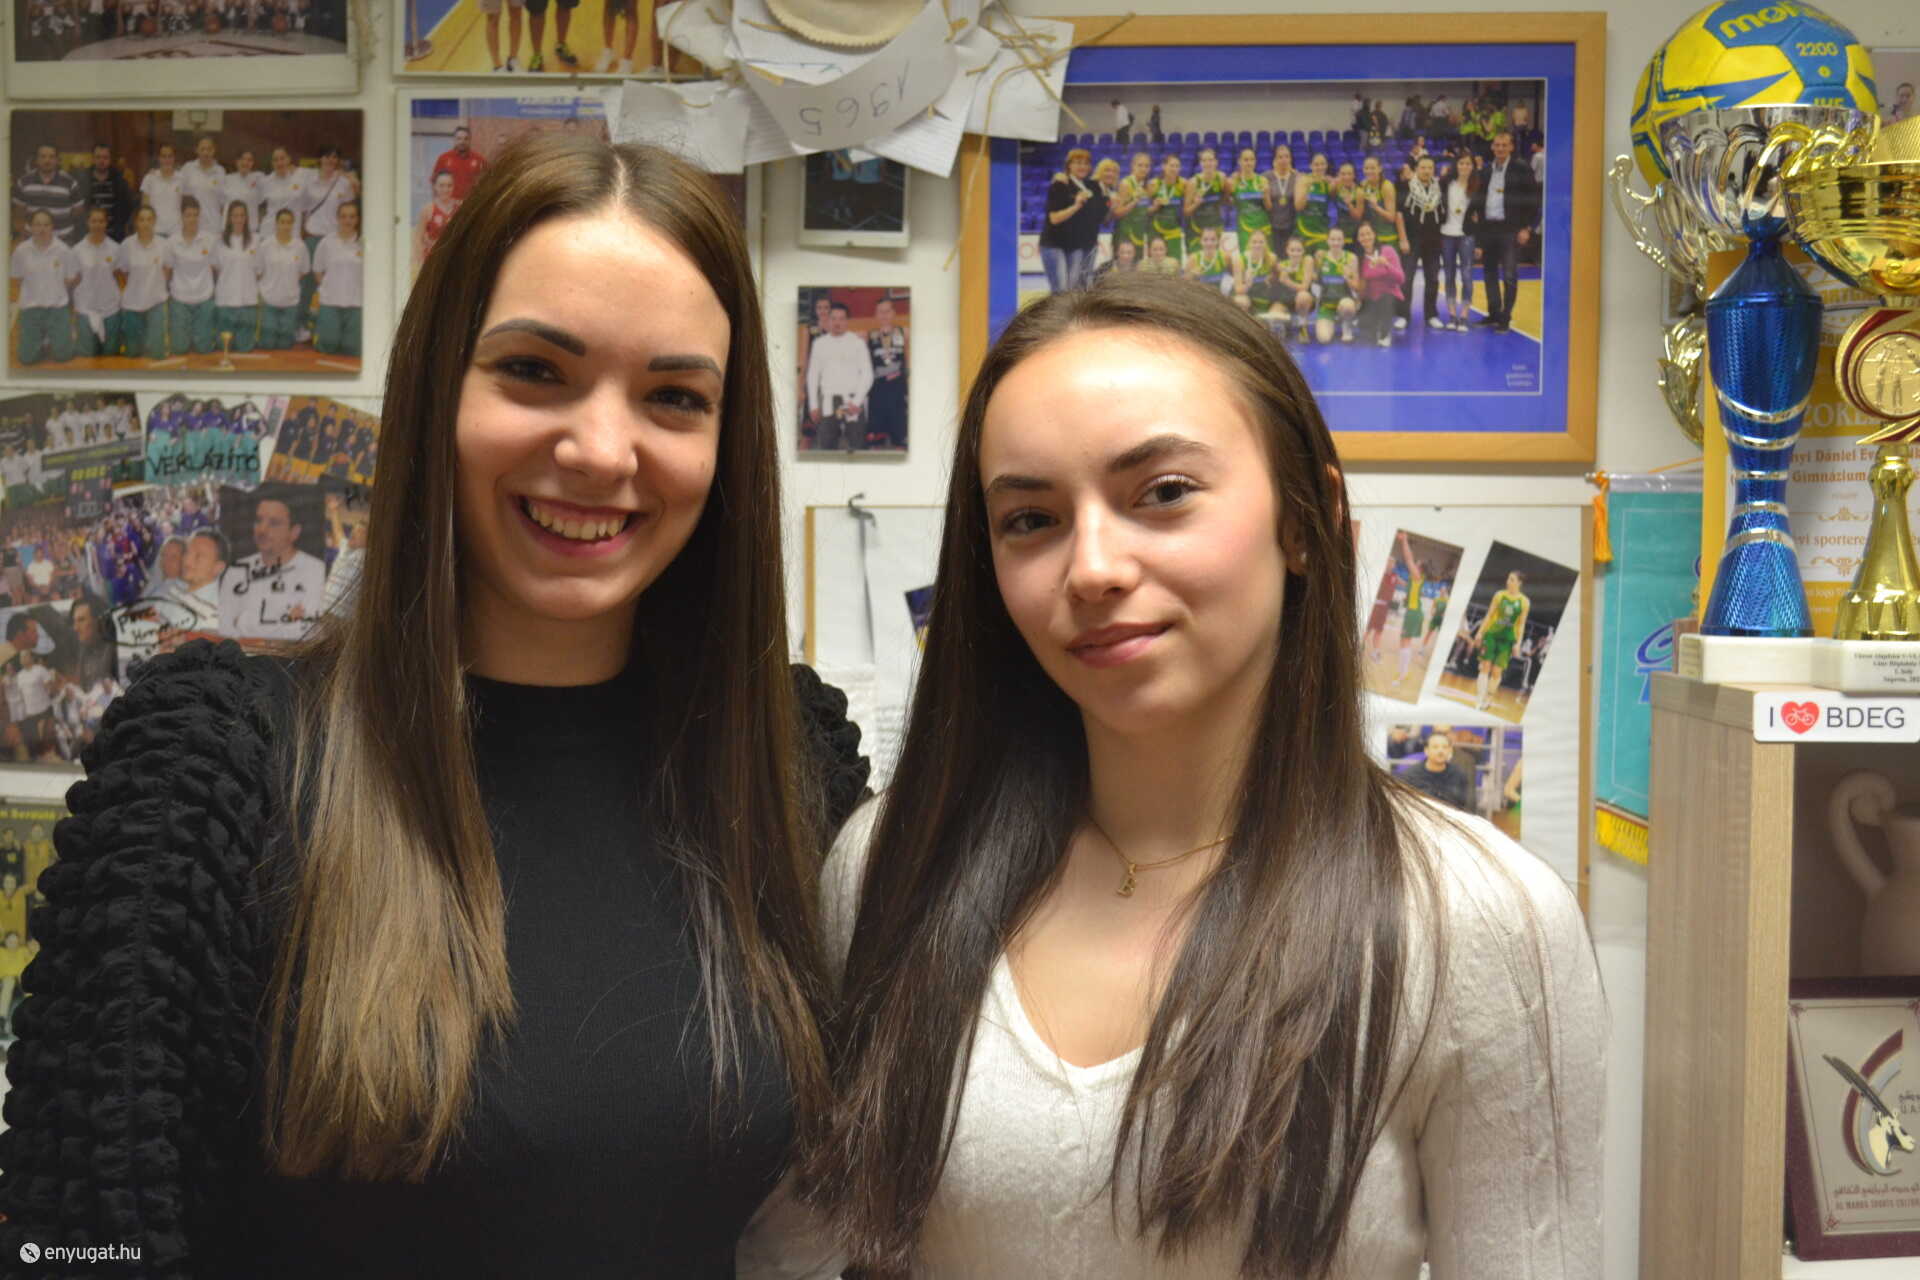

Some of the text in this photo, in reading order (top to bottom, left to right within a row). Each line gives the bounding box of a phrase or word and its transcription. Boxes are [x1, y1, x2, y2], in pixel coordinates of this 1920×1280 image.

[1796, 41, 1838, 57] 2200
[1769, 706, 1905, 729] I BDEG
